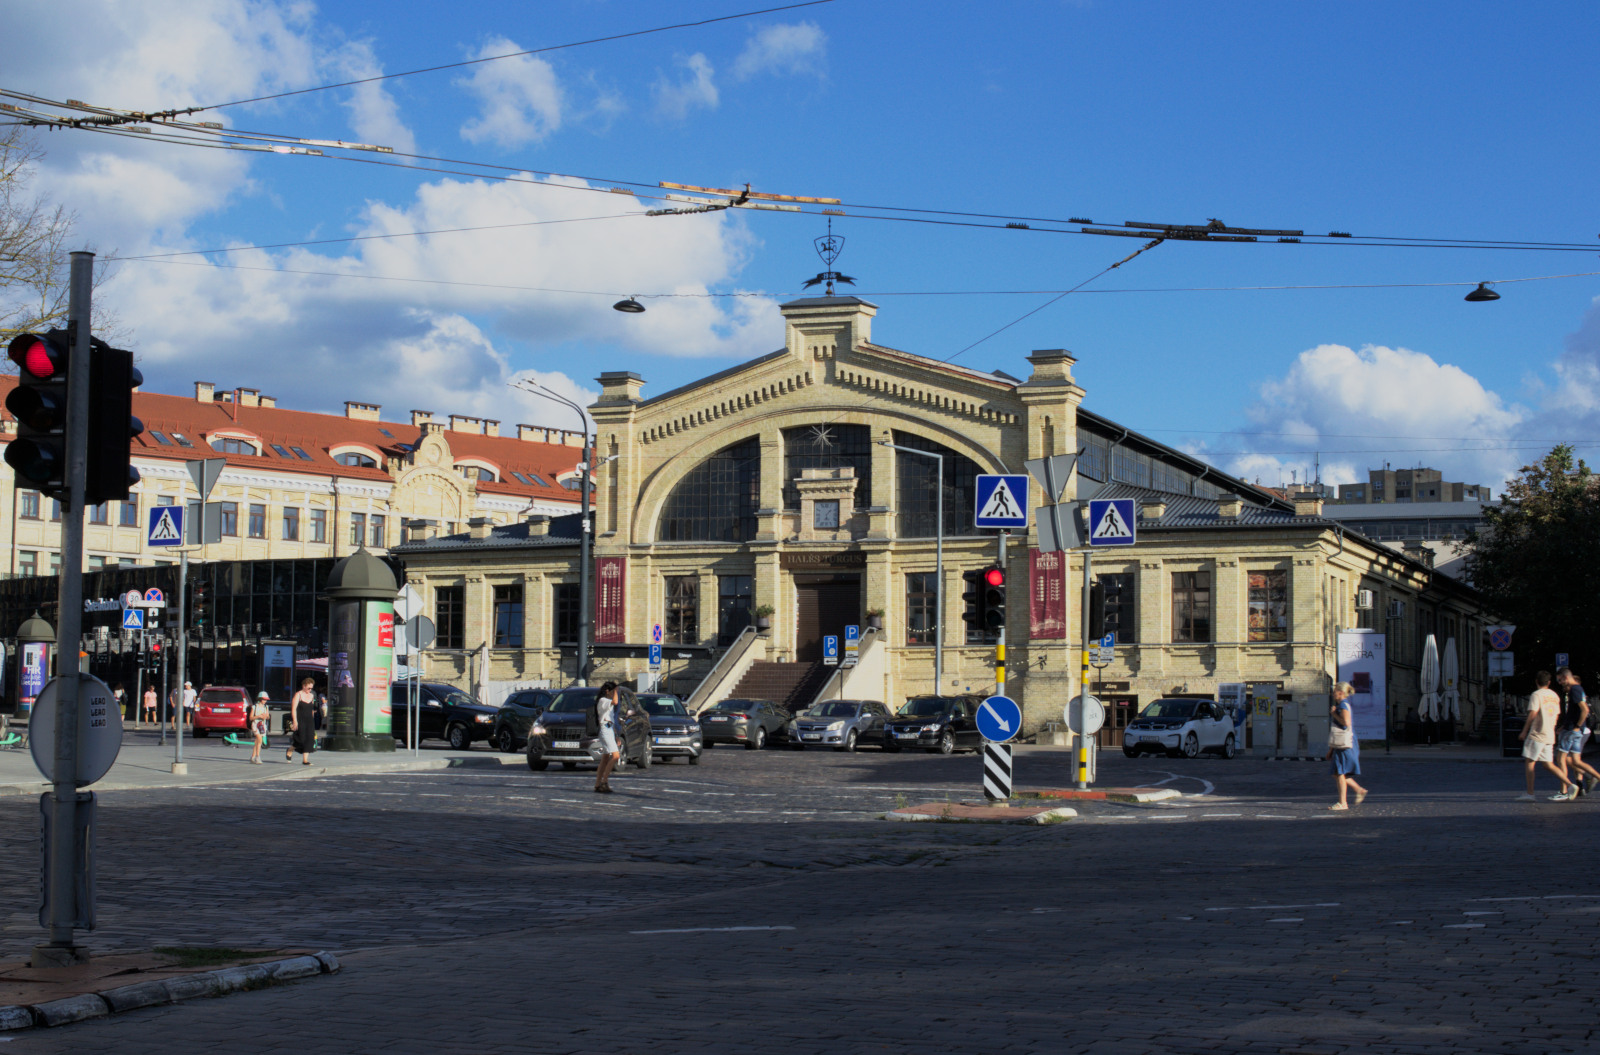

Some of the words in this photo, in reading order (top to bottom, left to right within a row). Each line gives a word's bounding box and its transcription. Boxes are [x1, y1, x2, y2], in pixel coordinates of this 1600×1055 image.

[823, 555, 862, 563] TURGUS
[849, 627, 857, 638] P
[827, 637, 835, 648] P
[1104, 634, 1113, 646] P
[652, 645, 660, 656] P
[1559, 654, 1567, 664] P
